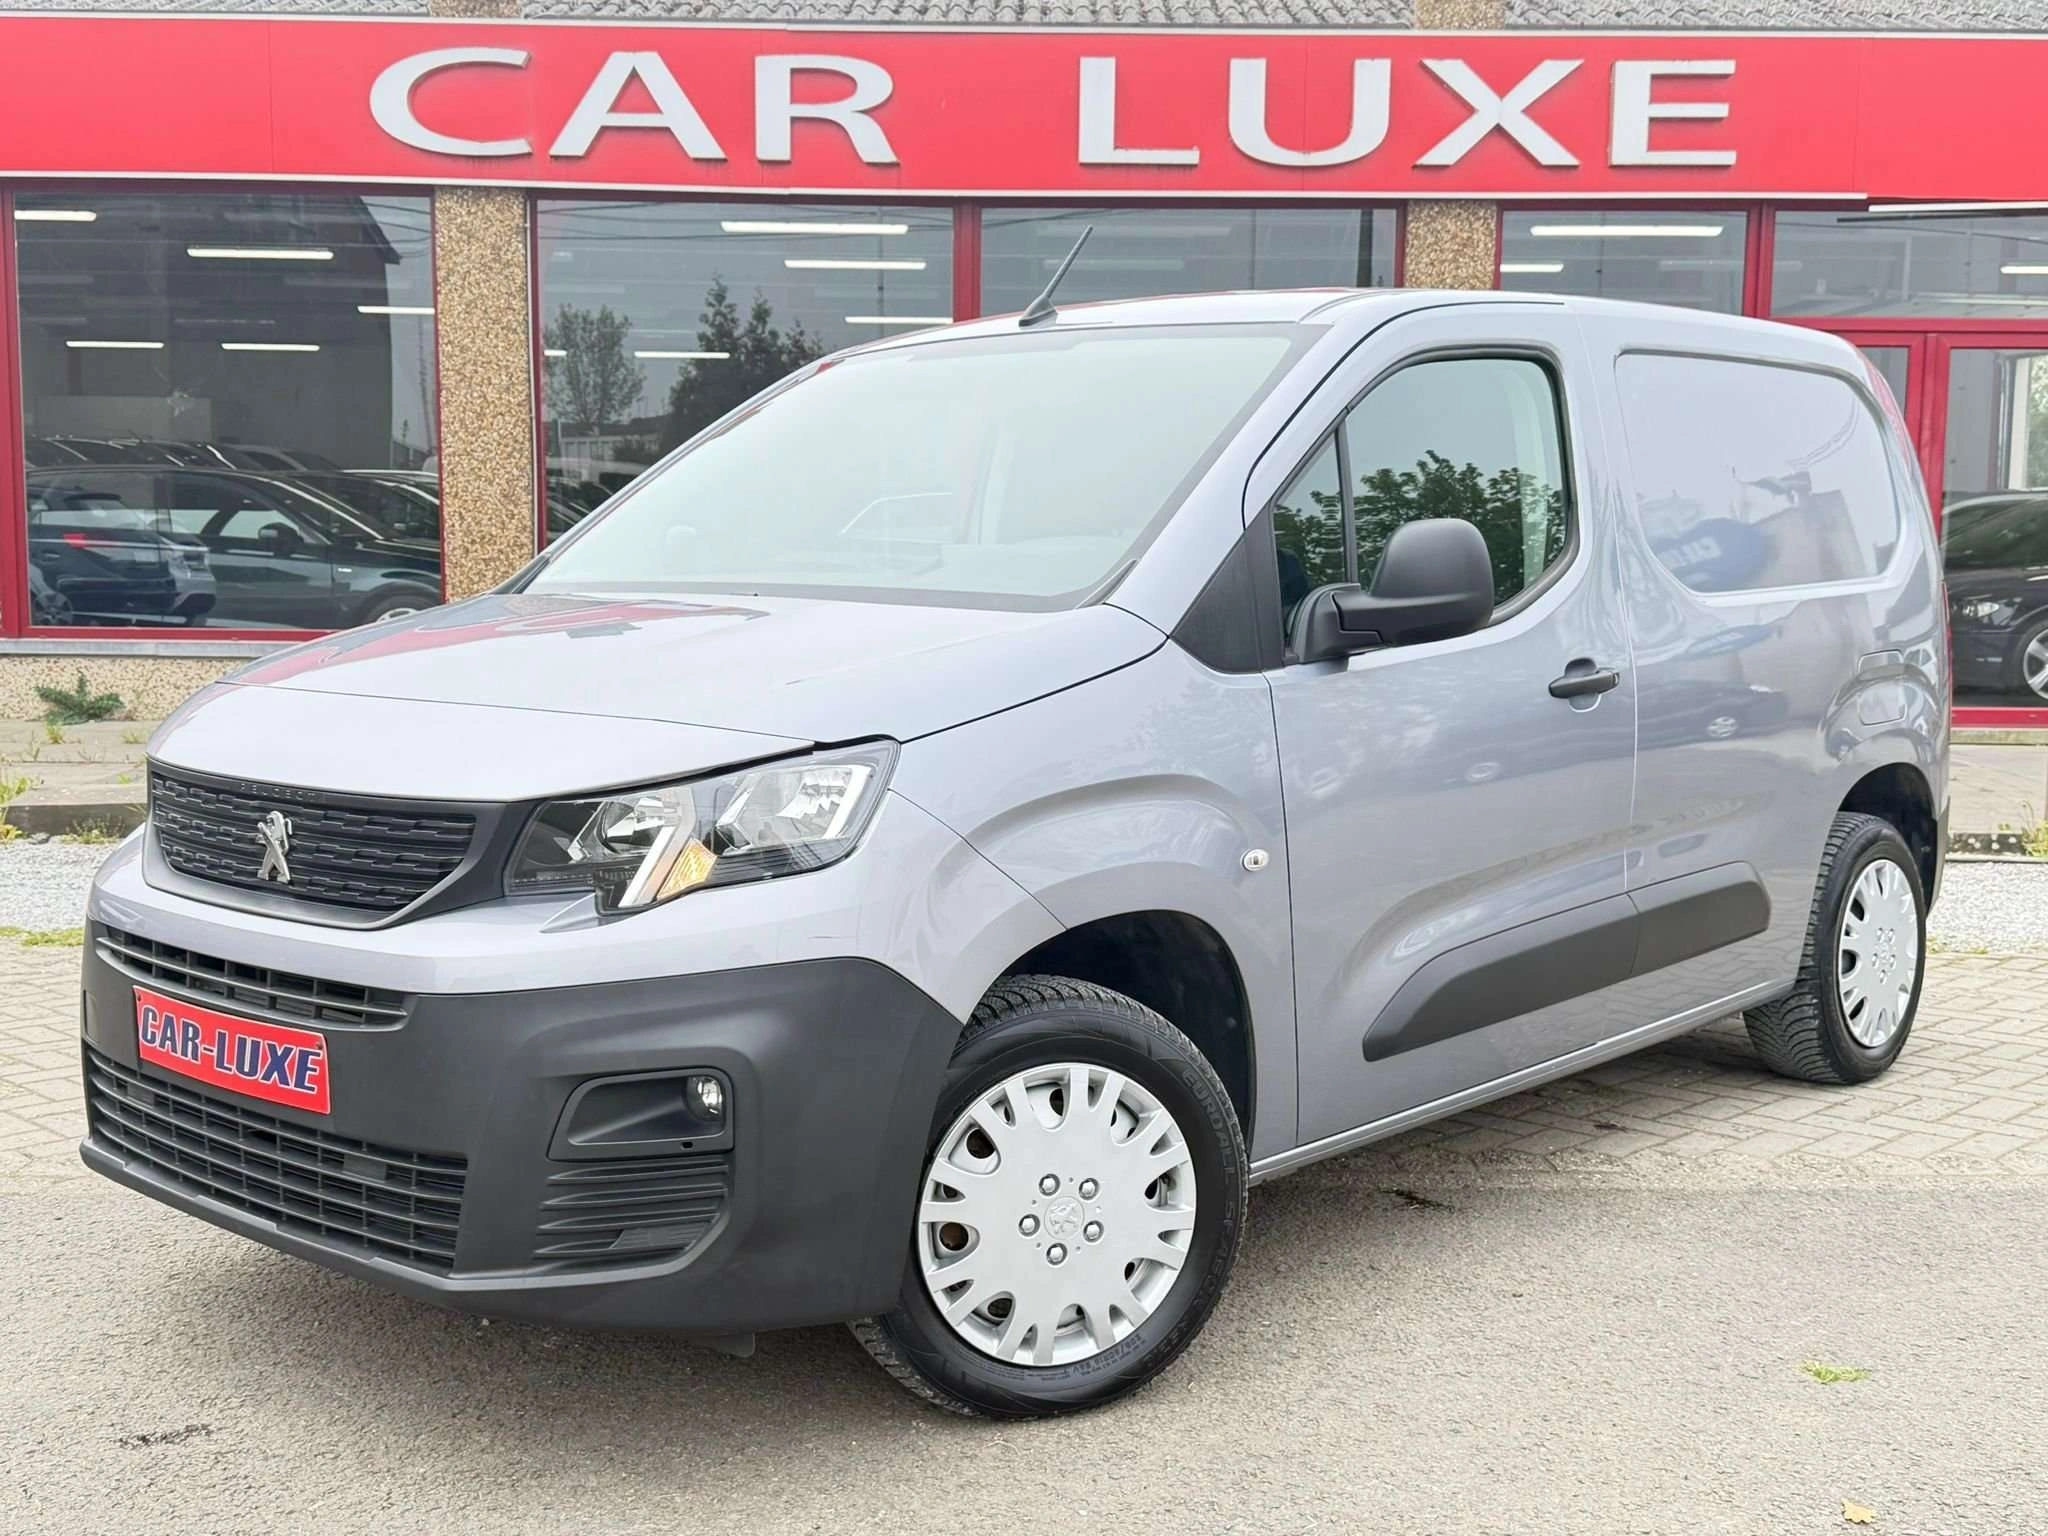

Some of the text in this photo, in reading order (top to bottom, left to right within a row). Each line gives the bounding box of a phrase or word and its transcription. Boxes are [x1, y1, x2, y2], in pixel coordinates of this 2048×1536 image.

[369, 47, 1738, 168] CAR LUXE
[139, 1005, 324, 1094] CAR-LUXE
